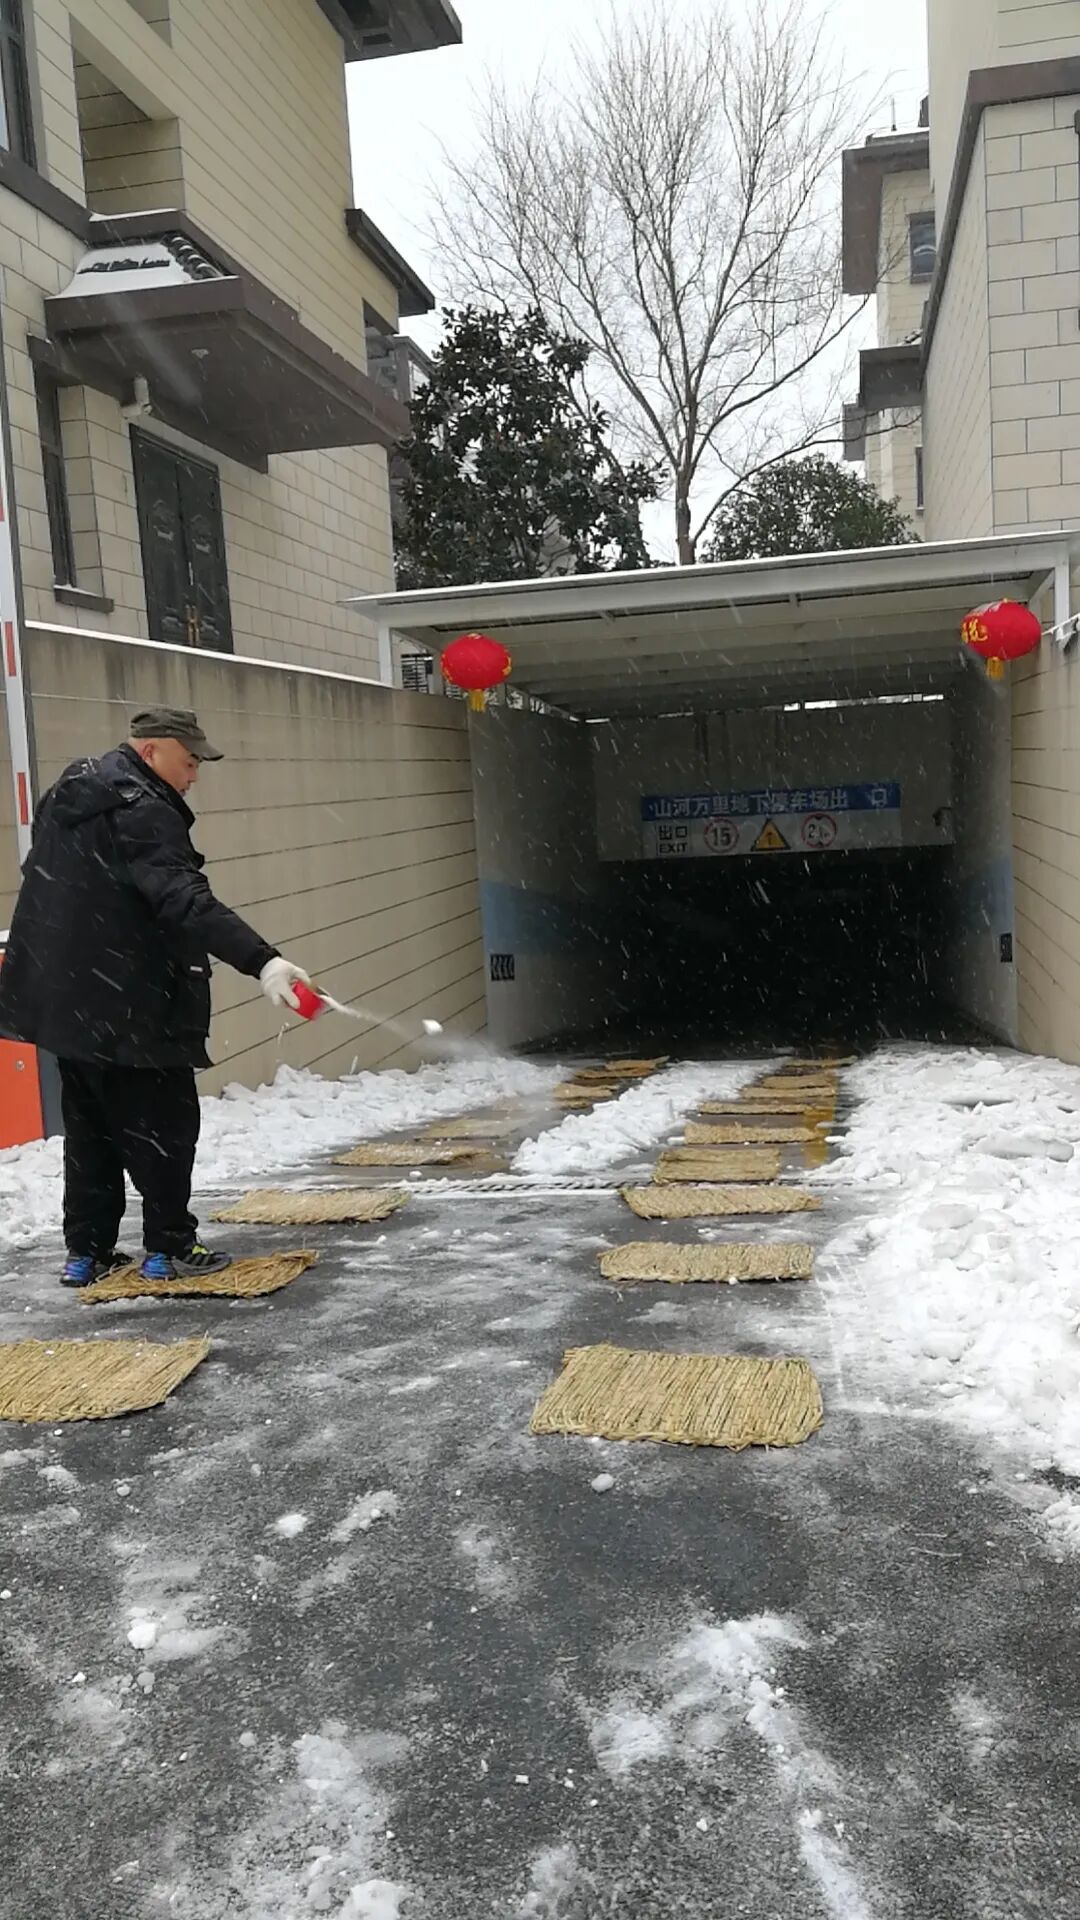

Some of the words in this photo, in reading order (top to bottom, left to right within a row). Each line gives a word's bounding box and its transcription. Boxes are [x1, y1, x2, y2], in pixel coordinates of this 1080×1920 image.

[659, 825, 688, 840] 出口
[711, 827, 730, 847] 15
[659, 842, 688, 853] EXIT
